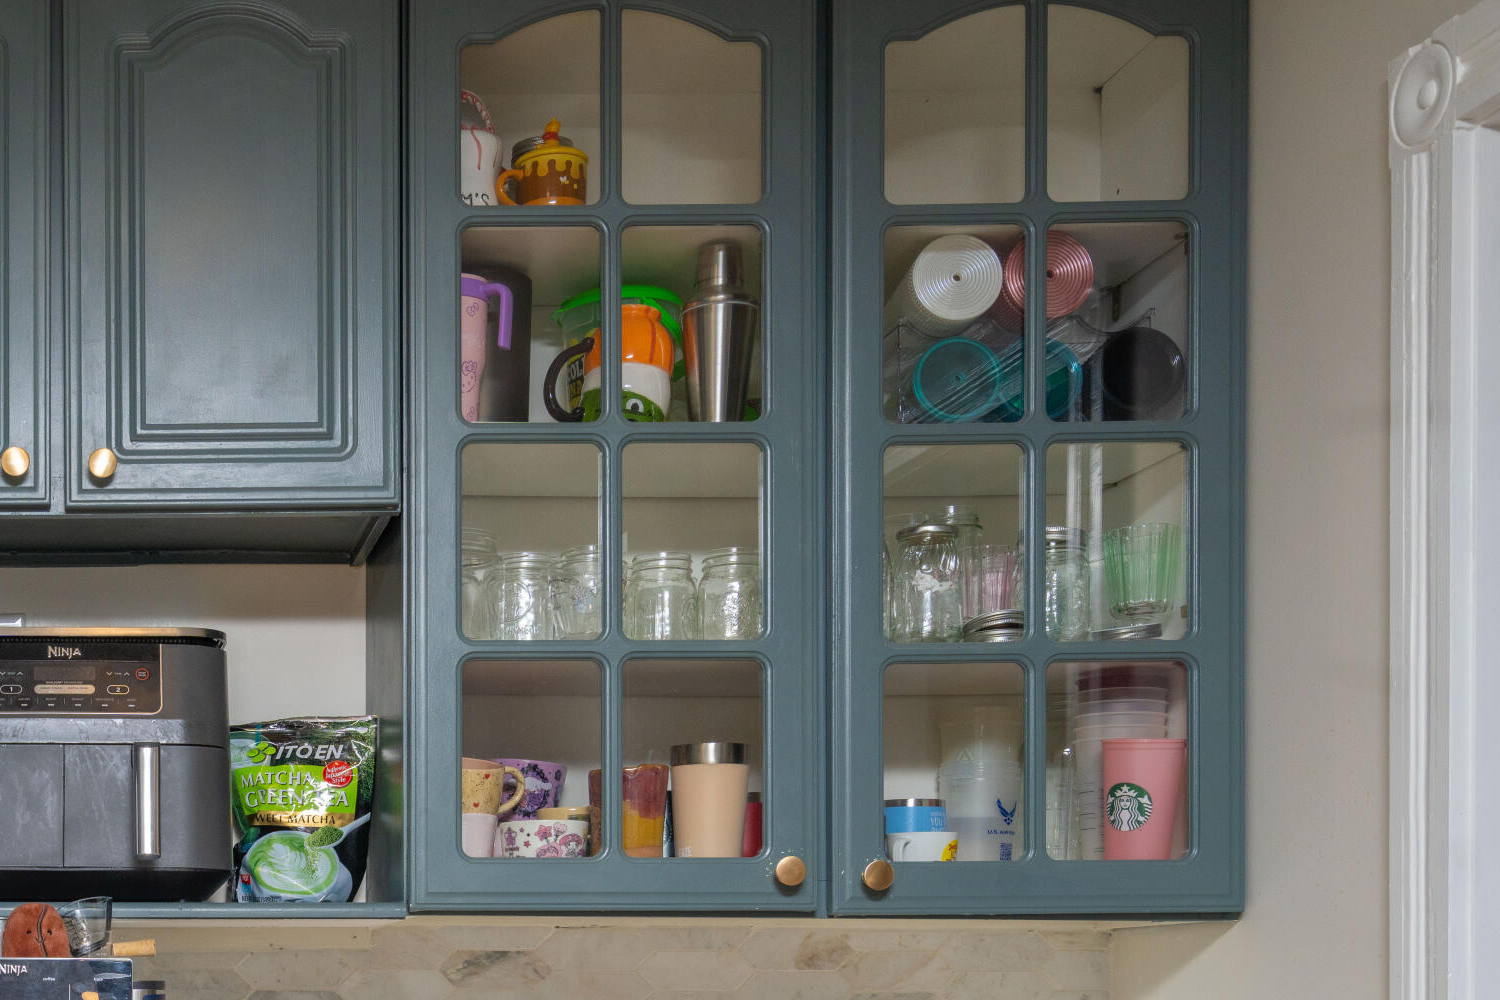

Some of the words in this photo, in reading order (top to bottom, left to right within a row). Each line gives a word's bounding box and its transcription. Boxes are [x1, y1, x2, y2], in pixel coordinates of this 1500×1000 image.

[47, 645, 82, 659] NINJA
[276, 743, 313, 760] ITO
[314, 744, 344, 760] EN
[241, 771, 315, 788] MATCHA
[245, 788, 305, 807] GREEN
[250, 813, 284, 823] WEET
[288, 813, 336, 824] MATCHA
